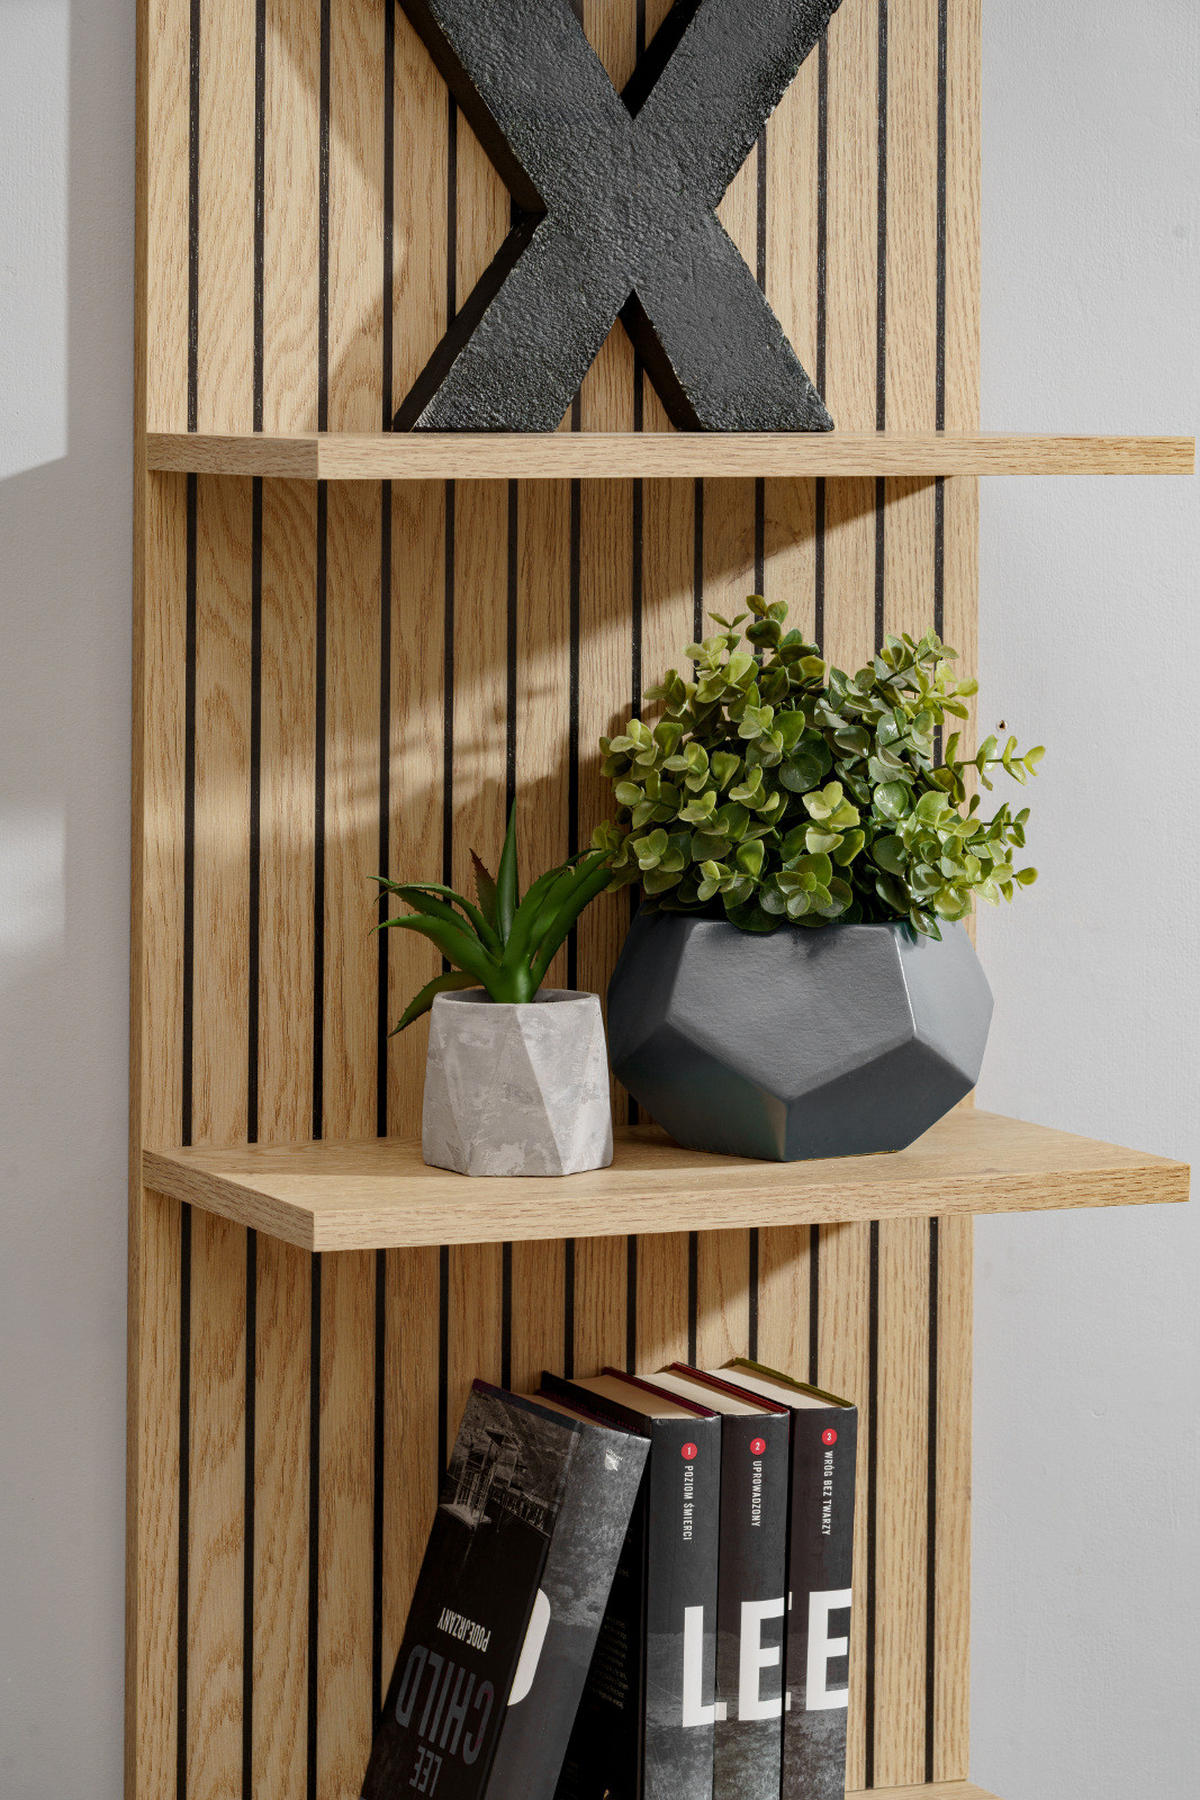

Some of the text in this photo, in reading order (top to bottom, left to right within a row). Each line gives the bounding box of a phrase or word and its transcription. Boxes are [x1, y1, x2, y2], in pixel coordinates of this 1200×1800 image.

[390, 0, 838, 432] X
[682, 1465, 695, 1541] POZIOM ŚMIERCI
[751, 1460, 763, 1528] UPROWADZONY
[821, 1450, 834, 1536] WRÓG BEZ TWARZY
[437, 1607, 491, 1653] PODEJRZANY
[395, 1644, 495, 1765] CHILD
[409, 1744, 443, 1798] LEE
